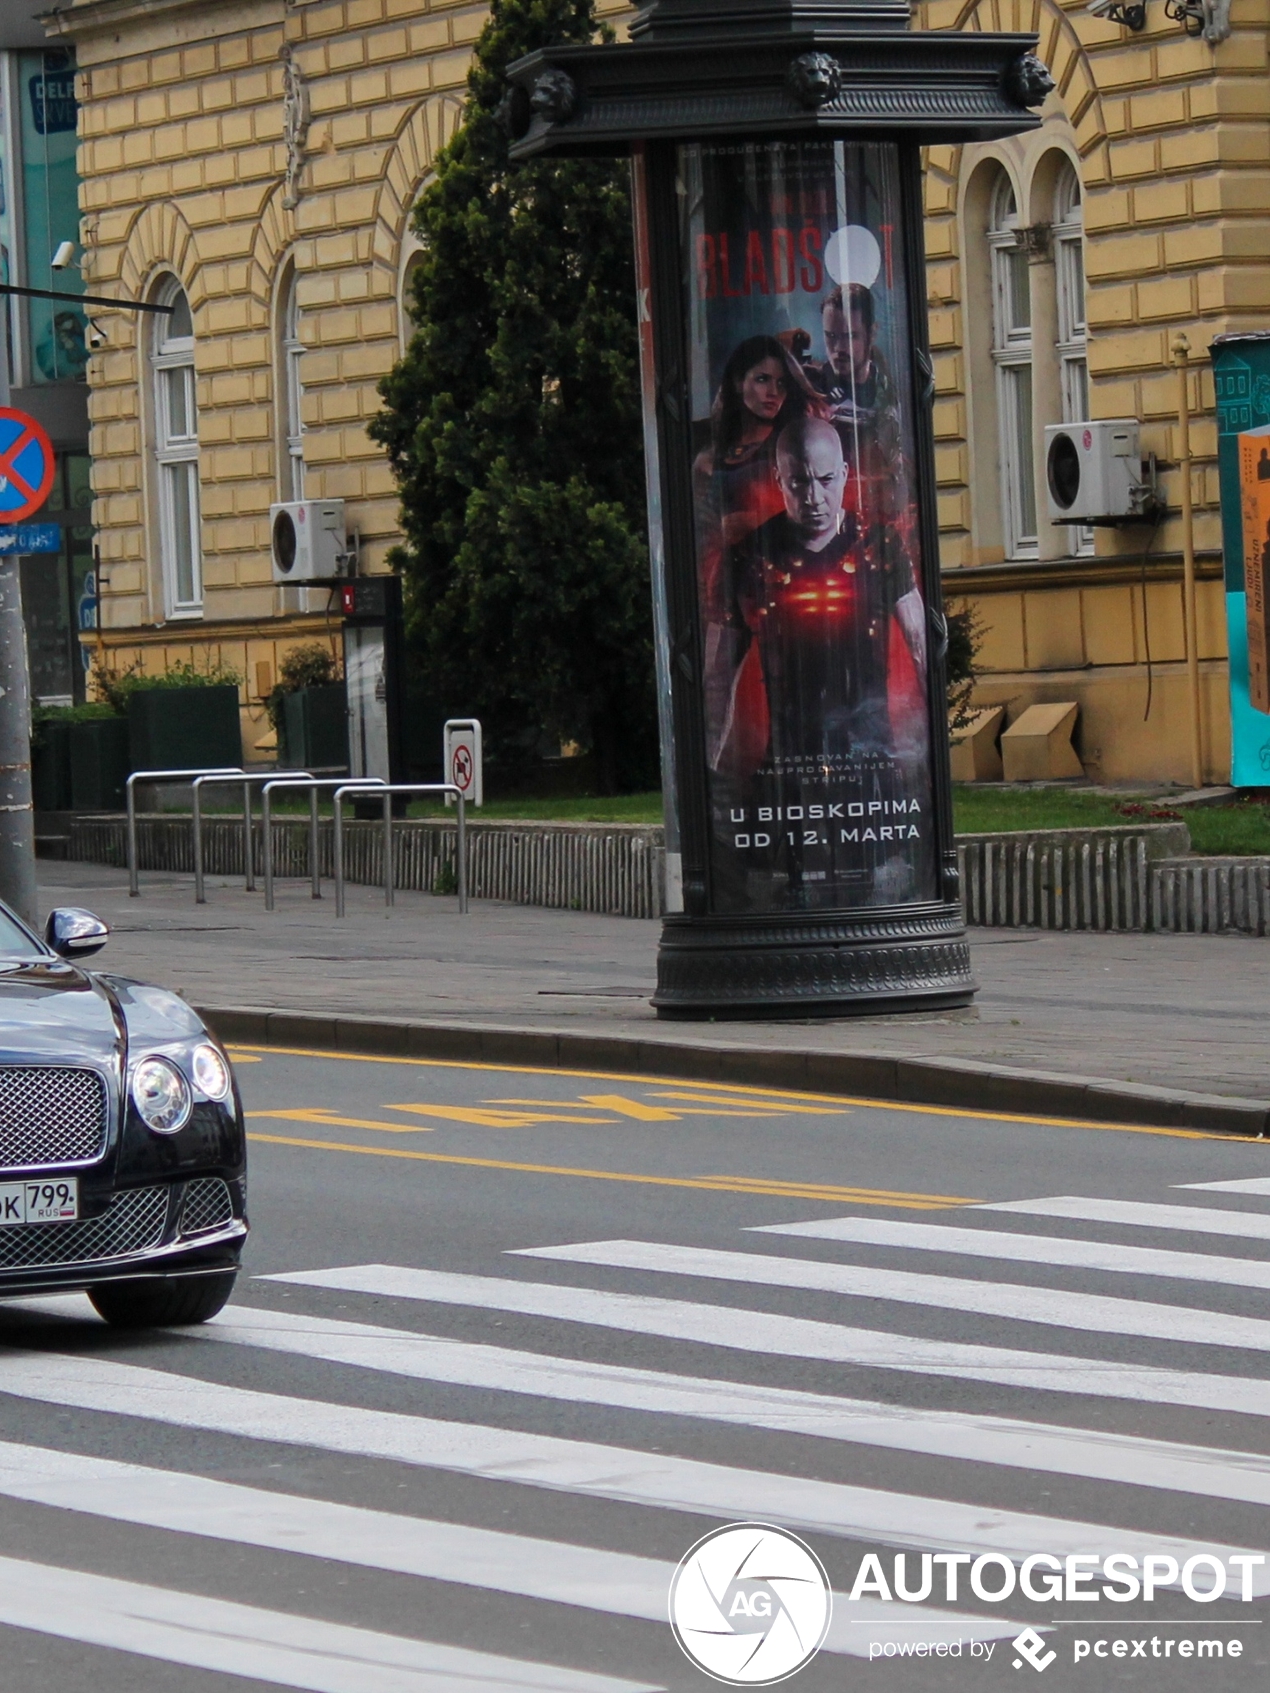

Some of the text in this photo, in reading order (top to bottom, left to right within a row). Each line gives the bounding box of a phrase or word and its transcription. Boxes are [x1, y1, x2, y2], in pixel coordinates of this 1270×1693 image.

[774, 750, 879, 764] ZASNOVAN NA
[730, 798, 921, 822] U BIOSKOPIMA
[734, 824, 921, 848] OD 12. MARTA
[27, 1183, 69, 1209] 799
[38, 1207, 59, 1218] RUS
